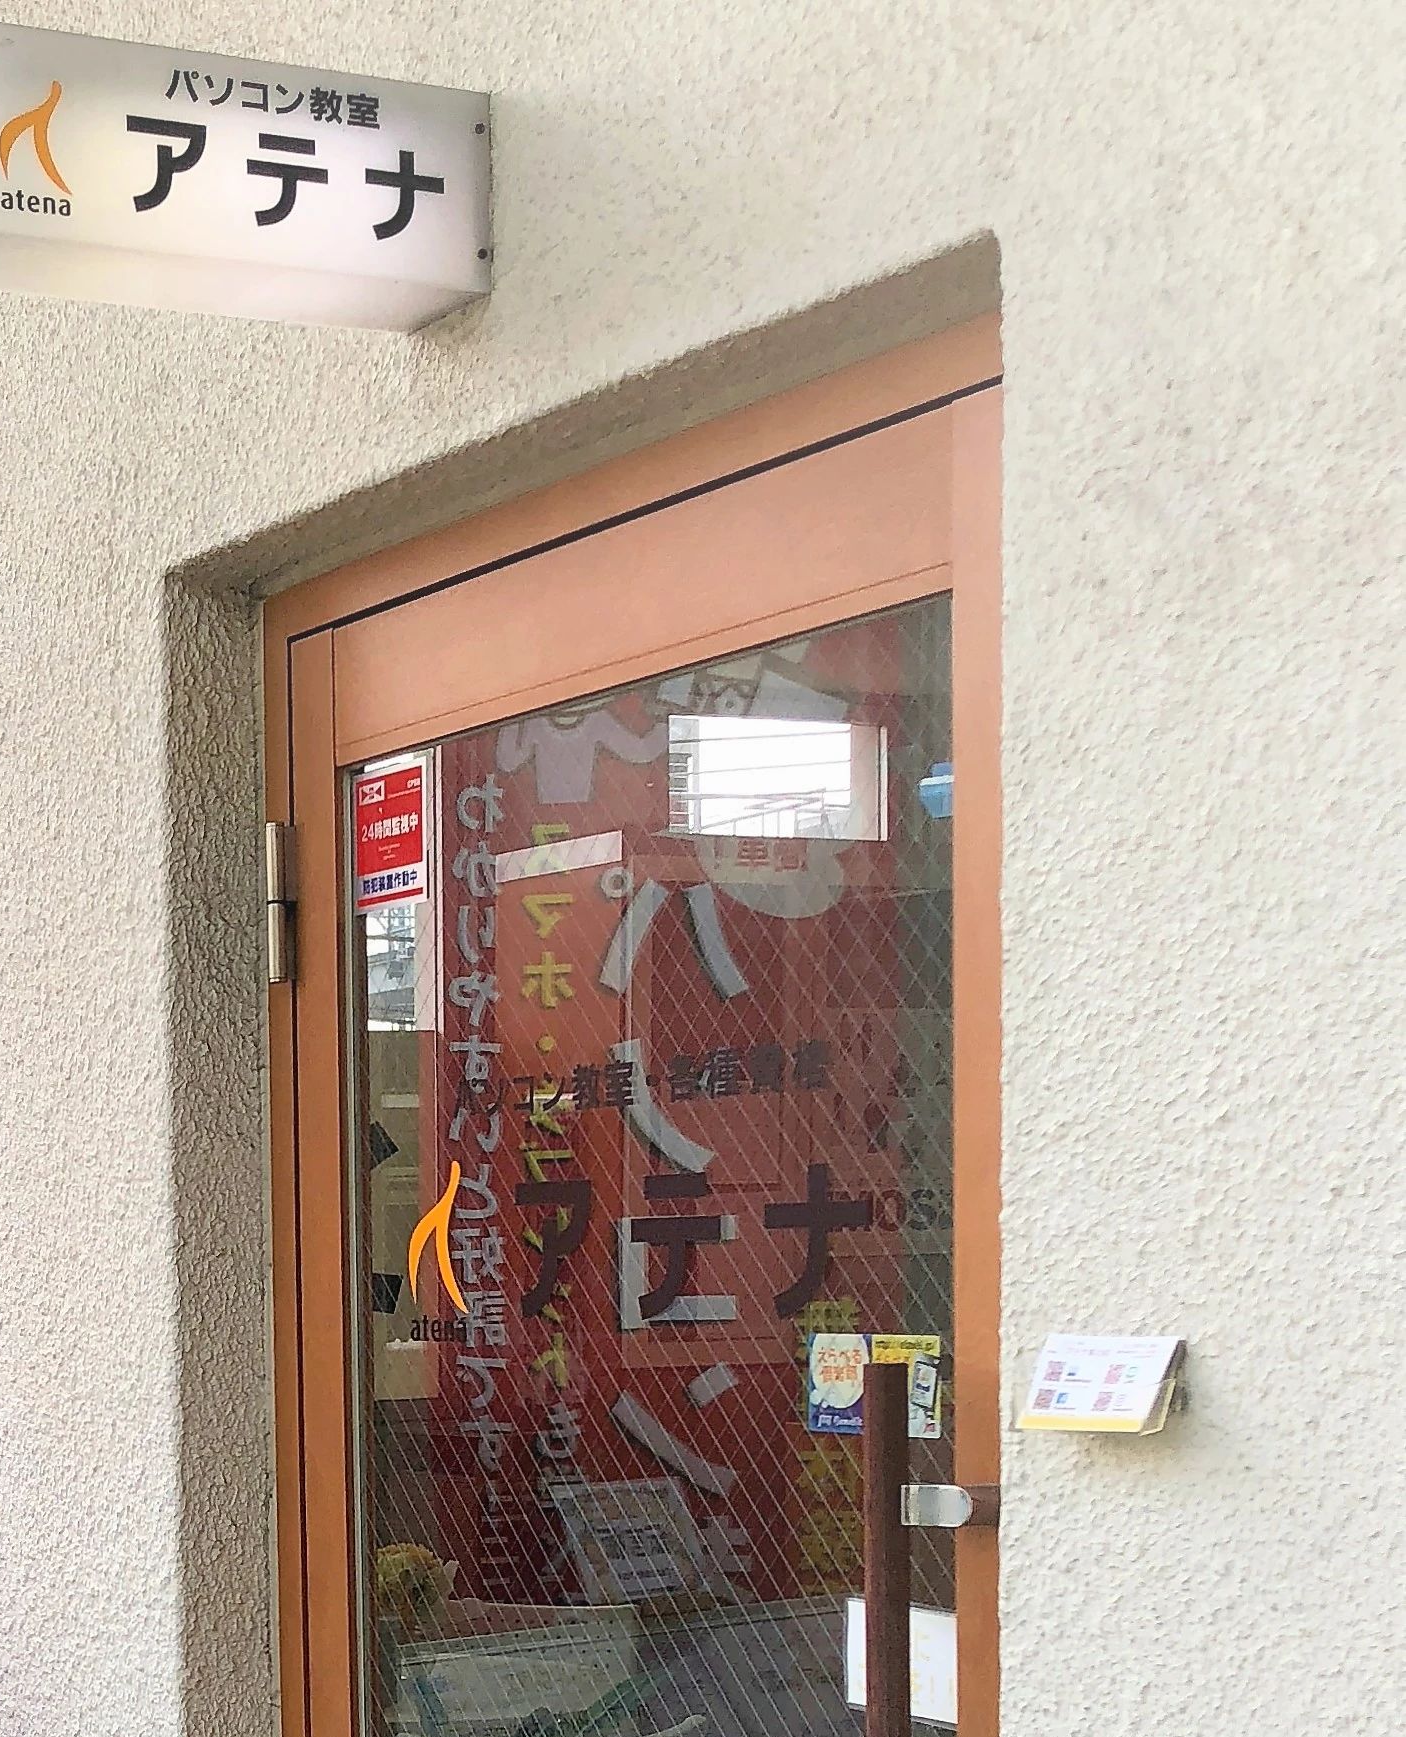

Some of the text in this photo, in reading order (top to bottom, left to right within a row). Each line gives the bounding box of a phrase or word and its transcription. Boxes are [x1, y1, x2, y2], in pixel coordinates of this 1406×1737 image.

[165, 68, 381, 131] パソコン教室
[0, 189, 72, 217] atena
[126, 114, 445, 241] アテナ
[514, 1163, 874, 1320] アテナ
